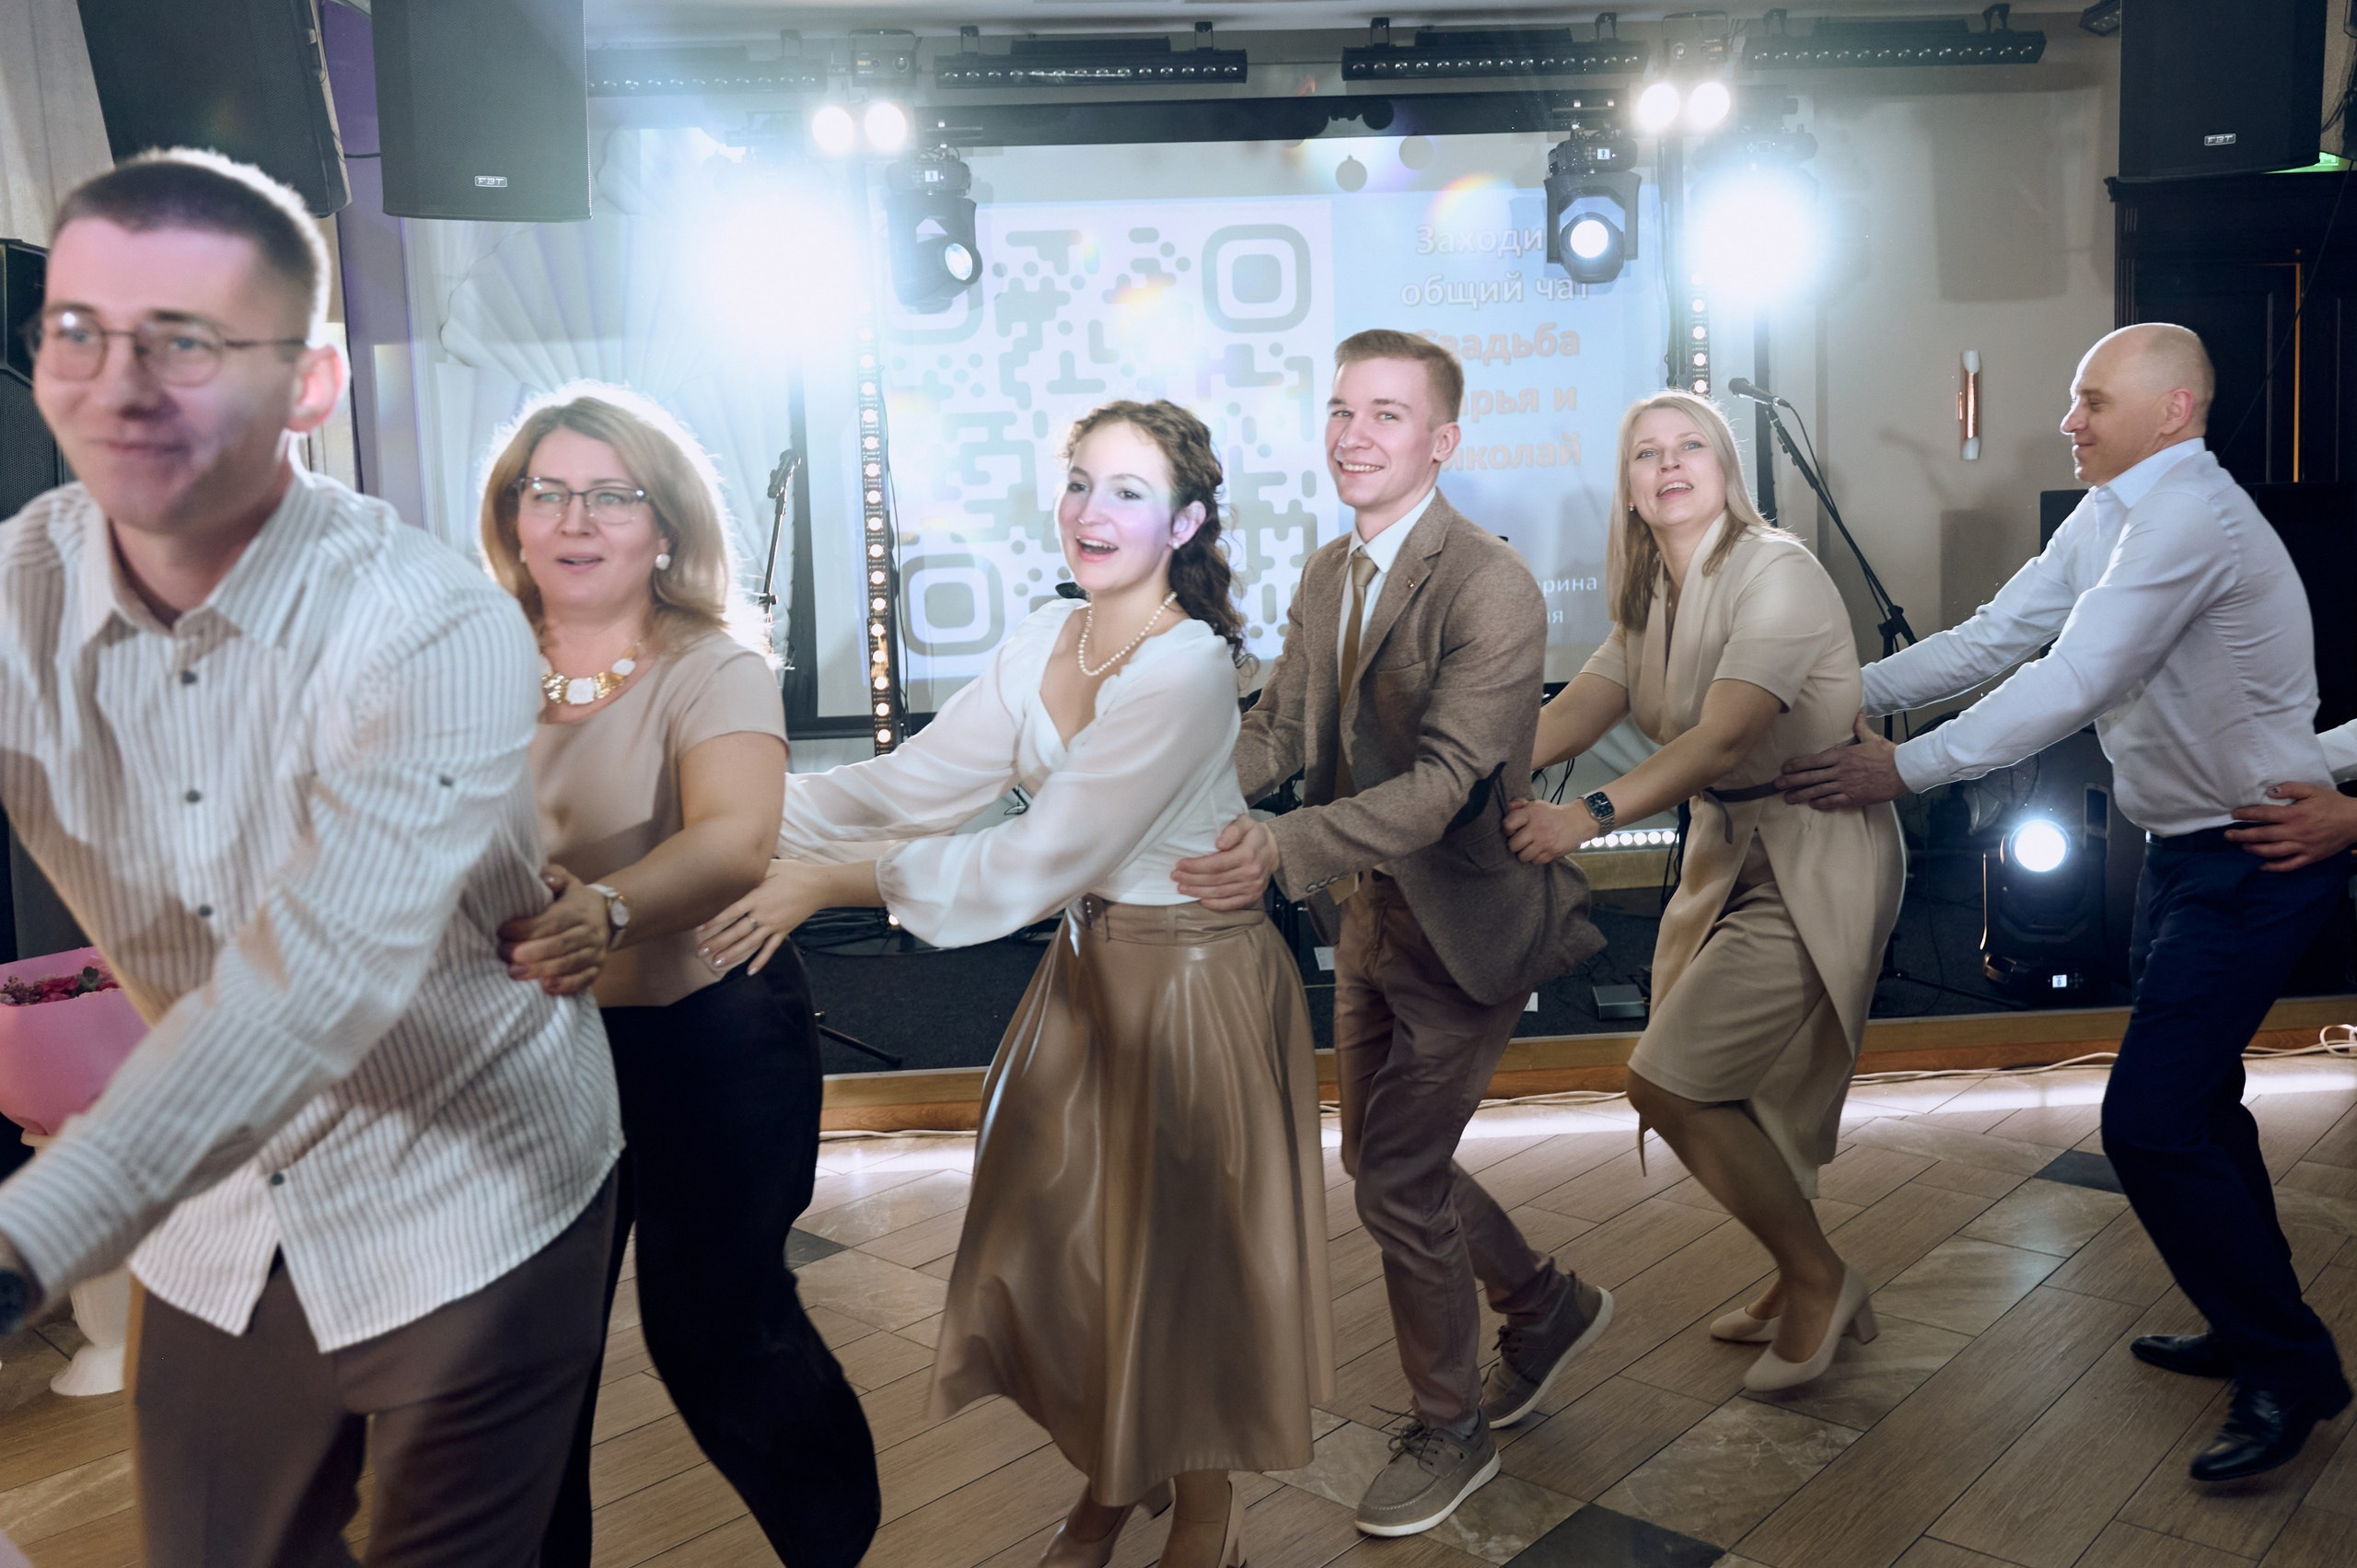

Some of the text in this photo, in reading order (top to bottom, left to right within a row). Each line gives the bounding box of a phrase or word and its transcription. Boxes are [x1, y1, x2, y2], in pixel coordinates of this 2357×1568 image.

[2207, 134, 2234, 144] FBT
[477, 177, 505, 185] FBT
[1415, 225, 1545, 258] Заходи
[1400, 272, 1524, 310] общий
[1460, 386, 1577, 424] рья и
[1440, 431, 1582, 472] иколай
[1539, 576, 1597, 598] рина
